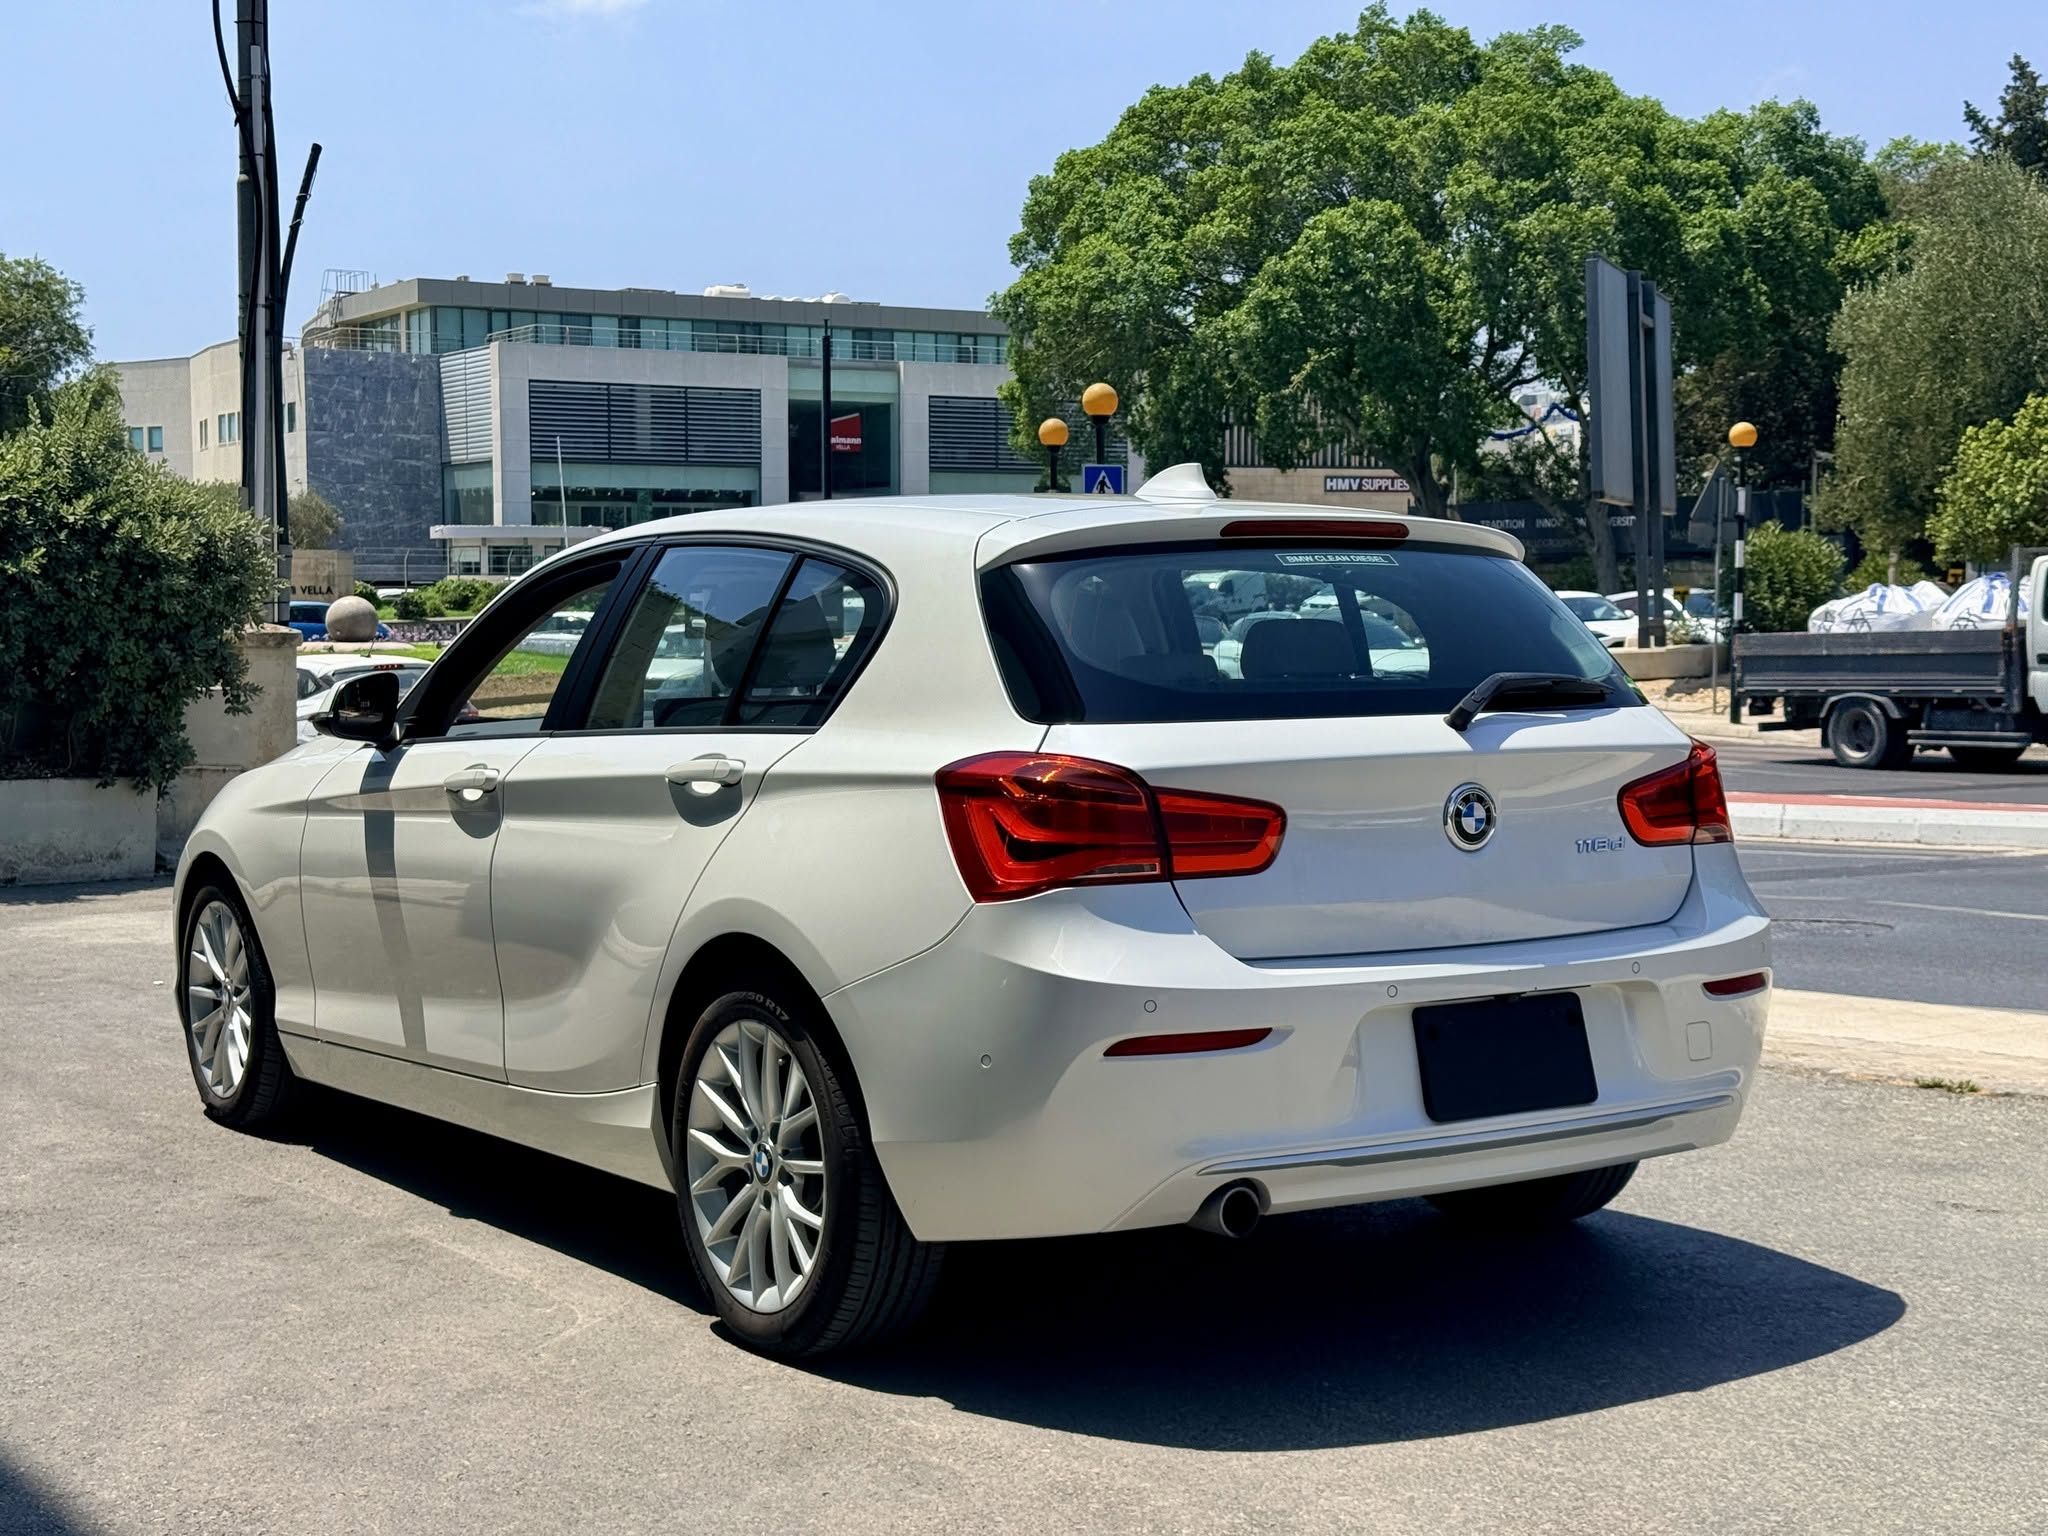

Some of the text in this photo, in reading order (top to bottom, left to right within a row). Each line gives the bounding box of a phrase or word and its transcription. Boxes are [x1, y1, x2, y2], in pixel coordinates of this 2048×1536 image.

[831, 436, 862, 444] almann
[1326, 478, 1410, 490] HMV SUPPLIES
[1286, 555, 1313, 563] BMW
[1350, 555, 1388, 563] DIESEL
[300, 586, 333, 595] VELLA
